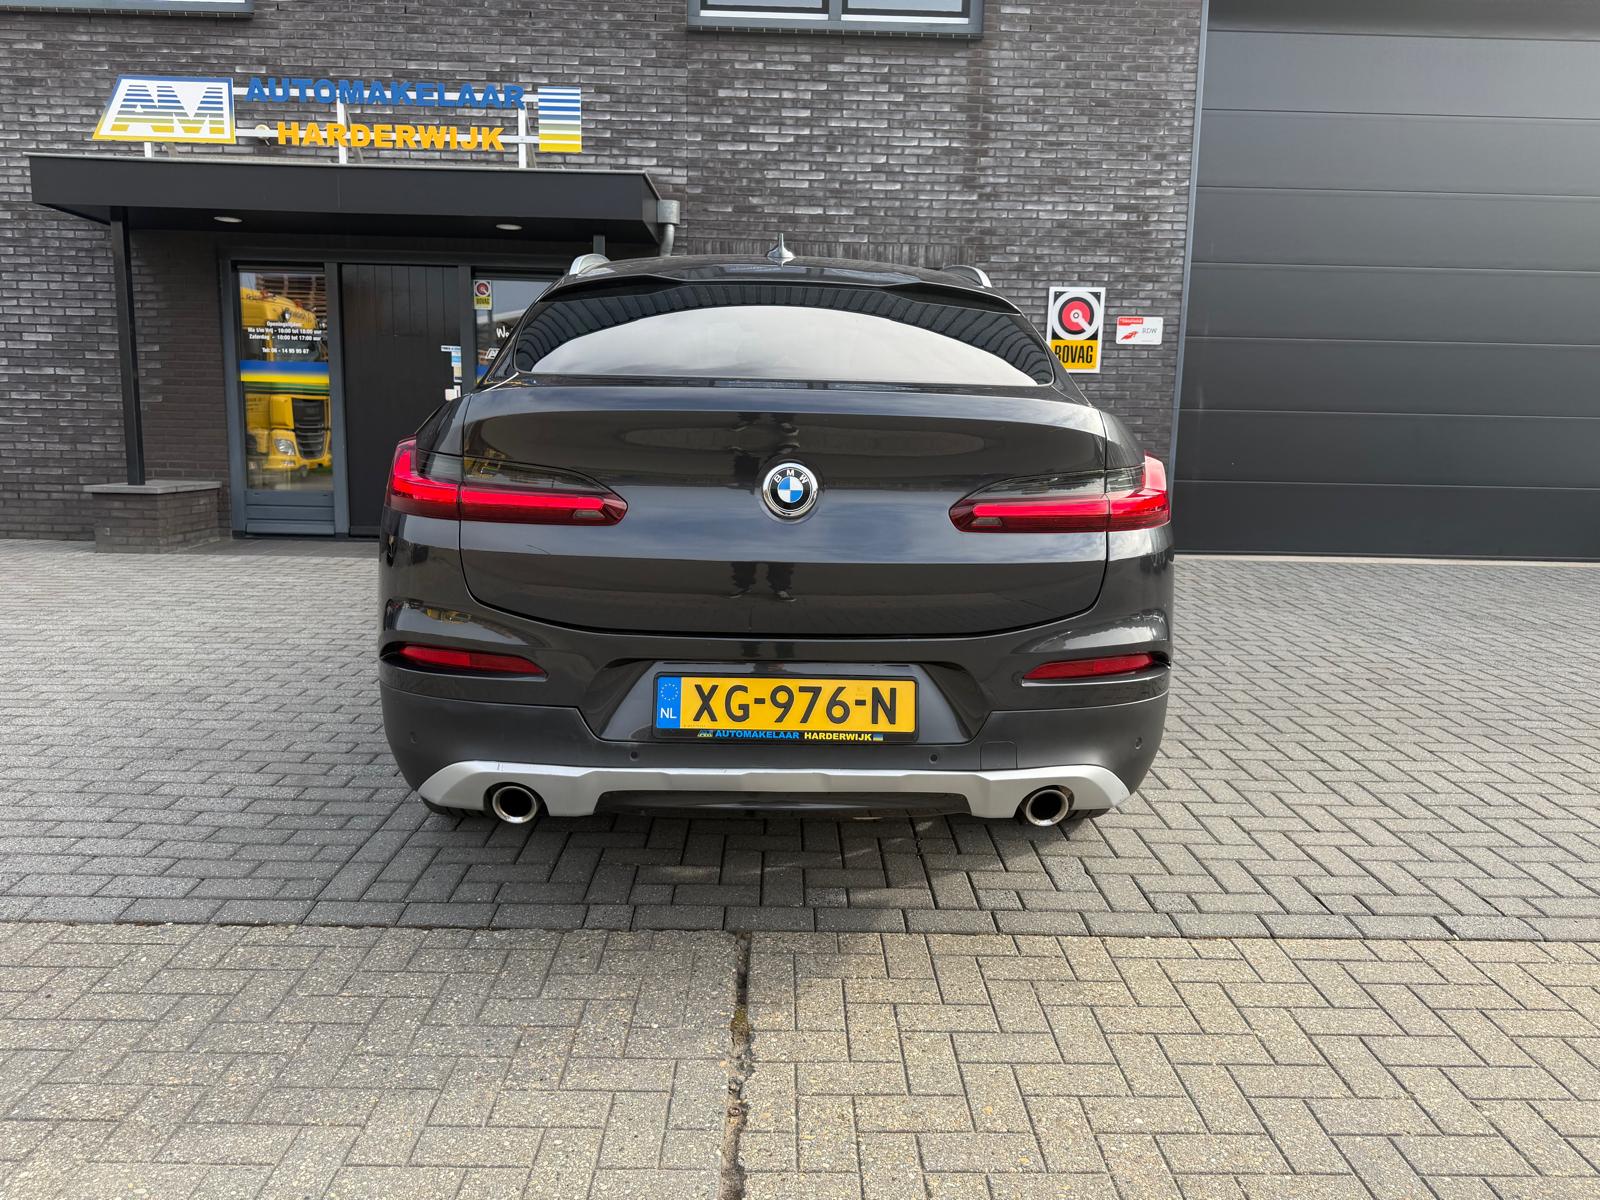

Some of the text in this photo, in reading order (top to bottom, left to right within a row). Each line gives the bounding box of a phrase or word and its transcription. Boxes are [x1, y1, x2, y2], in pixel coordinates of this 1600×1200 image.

[245, 77, 525, 110] AUTOMAKELAAR
[110, 84, 225, 136] AM
[277, 121, 506, 151] HARDERWIJK
[1055, 344, 1093, 364] BOVAG
[773, 469, 810, 484] BMW
[660, 707, 678, 719] NL
[693, 684, 897, 725] XG-976-N
[715, 730, 800, 740] AUTOMAKELAAR
[804, 732, 872, 742] HARDERWIJK
